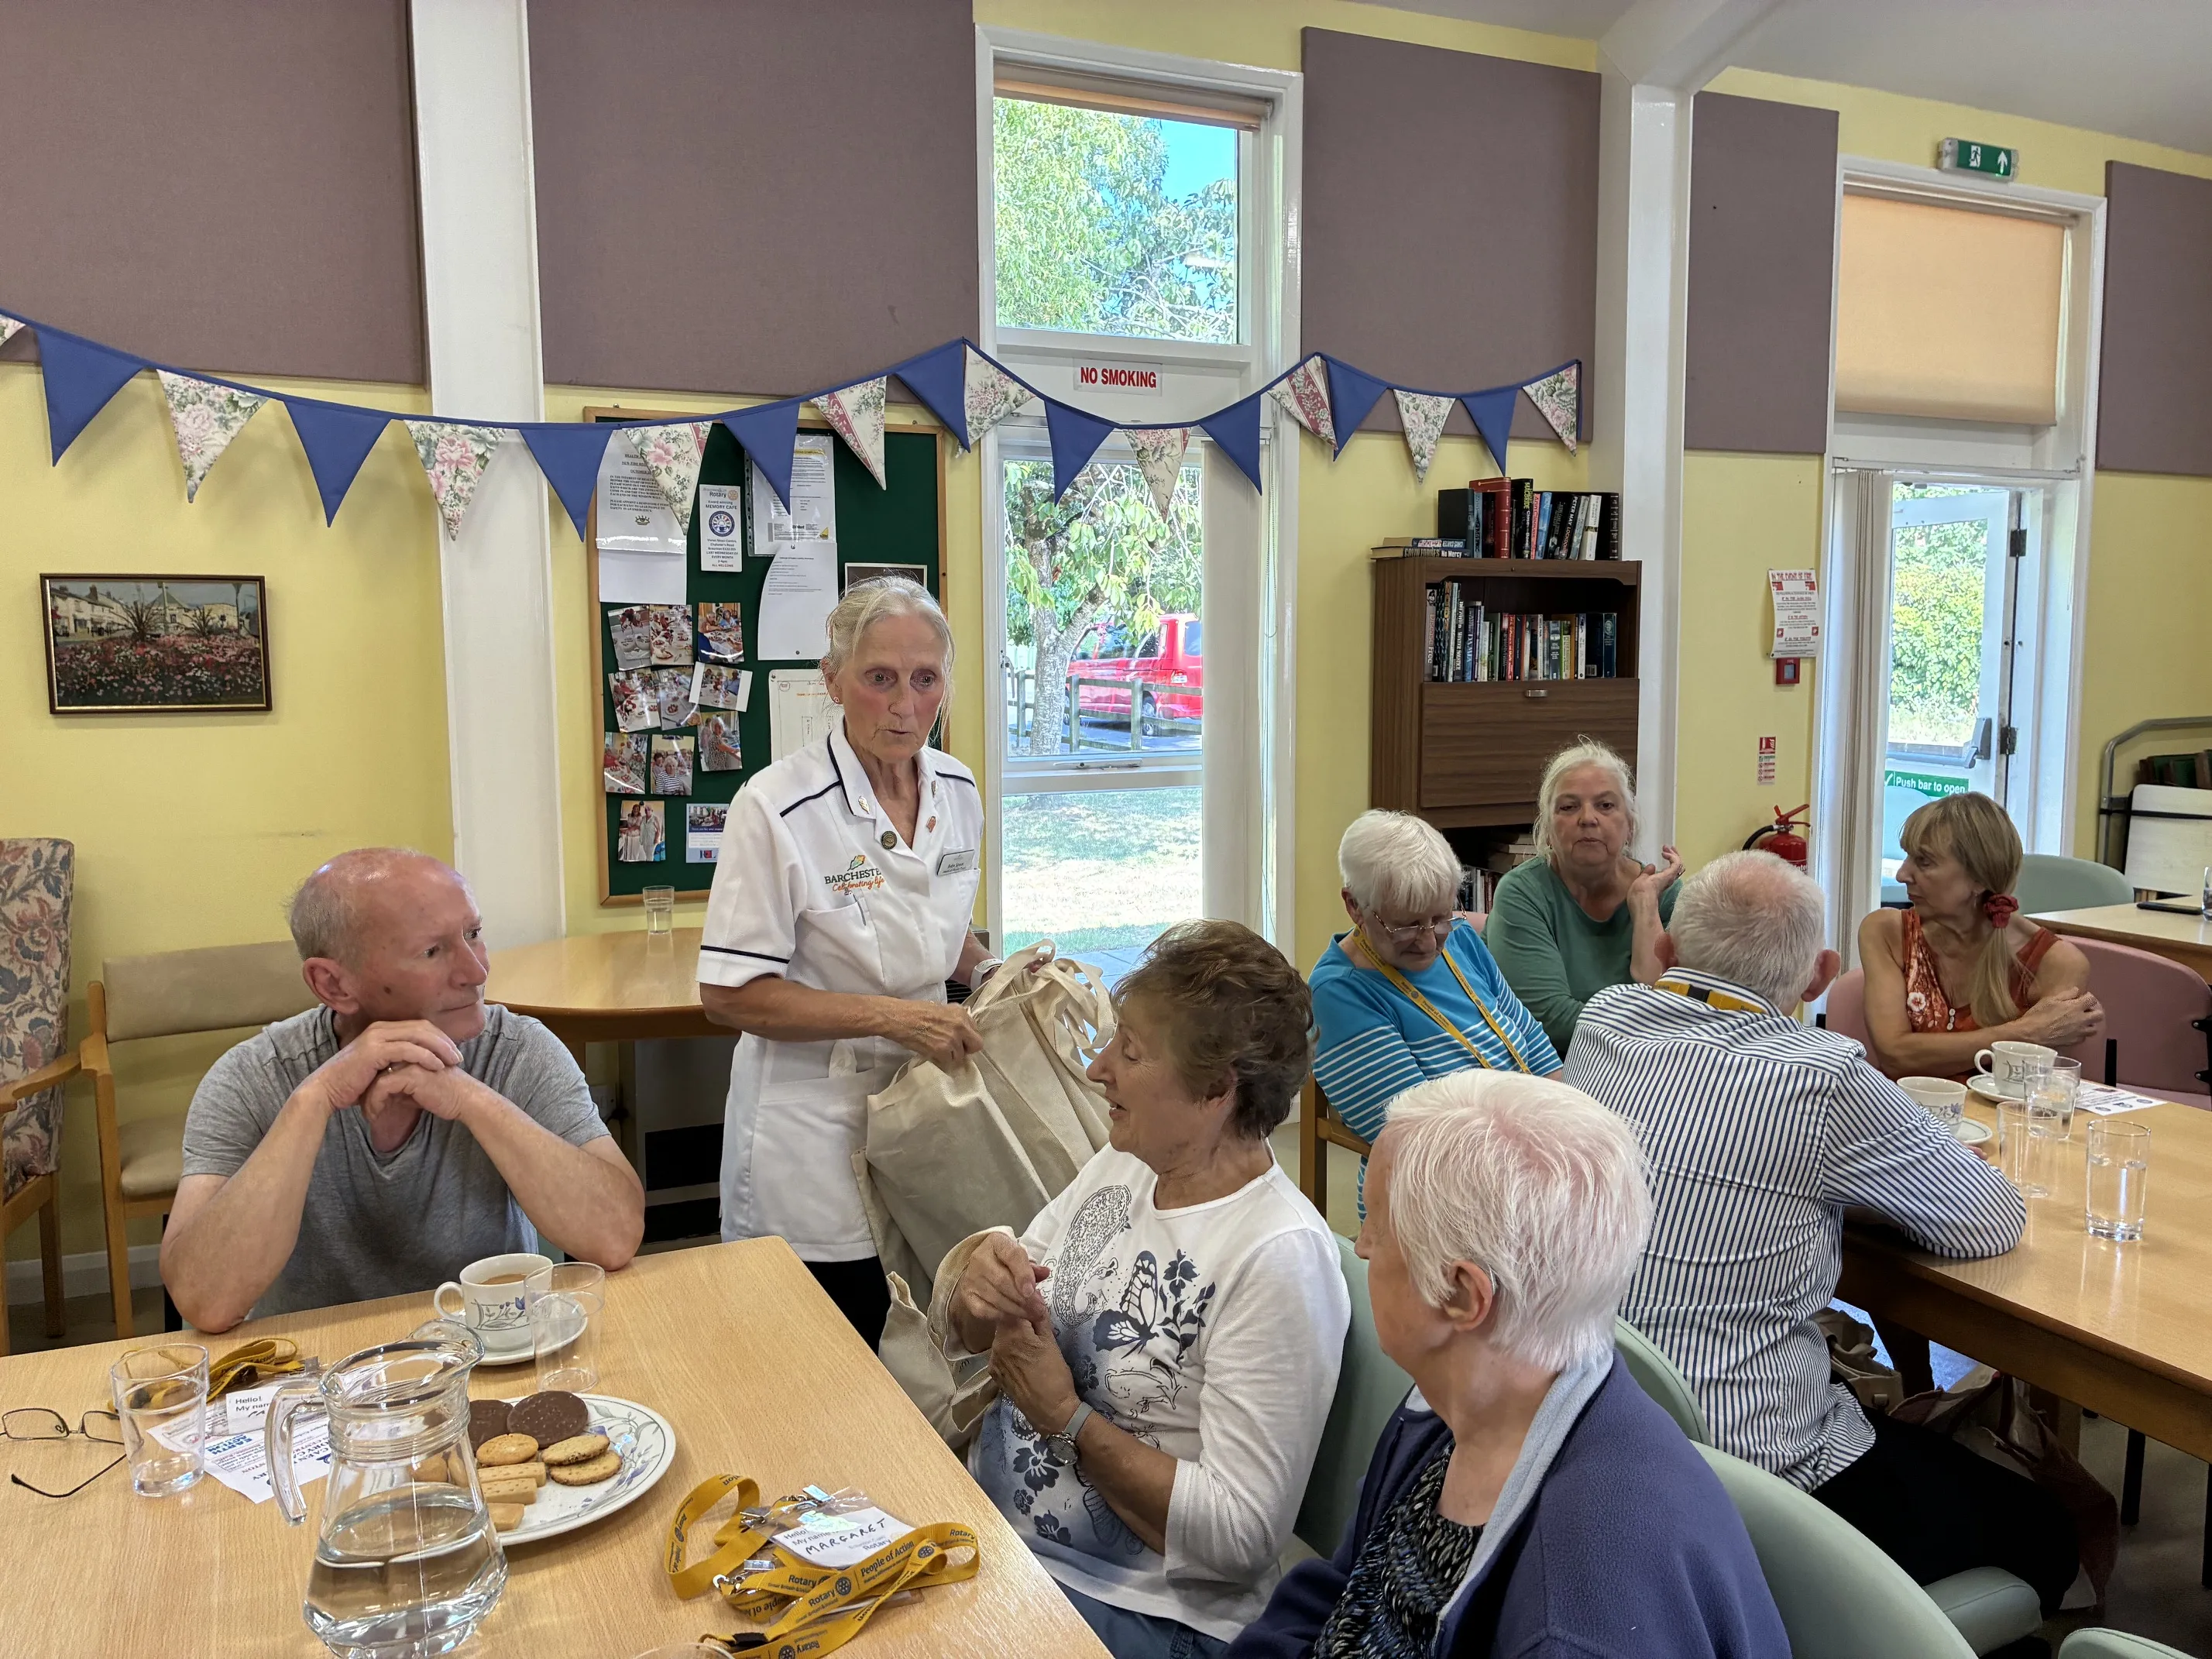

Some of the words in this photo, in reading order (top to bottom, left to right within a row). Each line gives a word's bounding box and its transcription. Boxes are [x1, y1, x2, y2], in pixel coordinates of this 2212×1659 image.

[1080, 367, 1097, 384] NO
[1101, 369, 1156, 388] SMOKING
[1570, 496, 1578, 514] PETER
[1896, 776, 1916, 788] Push
[1918, 779, 1932, 790] bar
[1933, 782, 1942, 792] to
[1943, 785, 1966, 795] open
[824, 868, 882, 884] BARCHESTE
[235, 1396, 262, 1404] Hello!
[784, 1528, 809, 1539] Hello!
[792, 1537, 807, 1546] My
[808, 1531, 831, 1541] name
[805, 1518, 885, 1555] MARGARET
[950, 1529, 975, 1540] Rotary
[863, 1539, 891, 1551] Rotary
[860, 1558, 885, 1577] People
[885, 1550, 894, 1561] of
[895, 1540, 915, 1558] Action
[788, 1575, 817, 1589] Rotary
[809, 1589, 836, 1606] Rotary
[797, 1640, 820, 1654] Rotary
